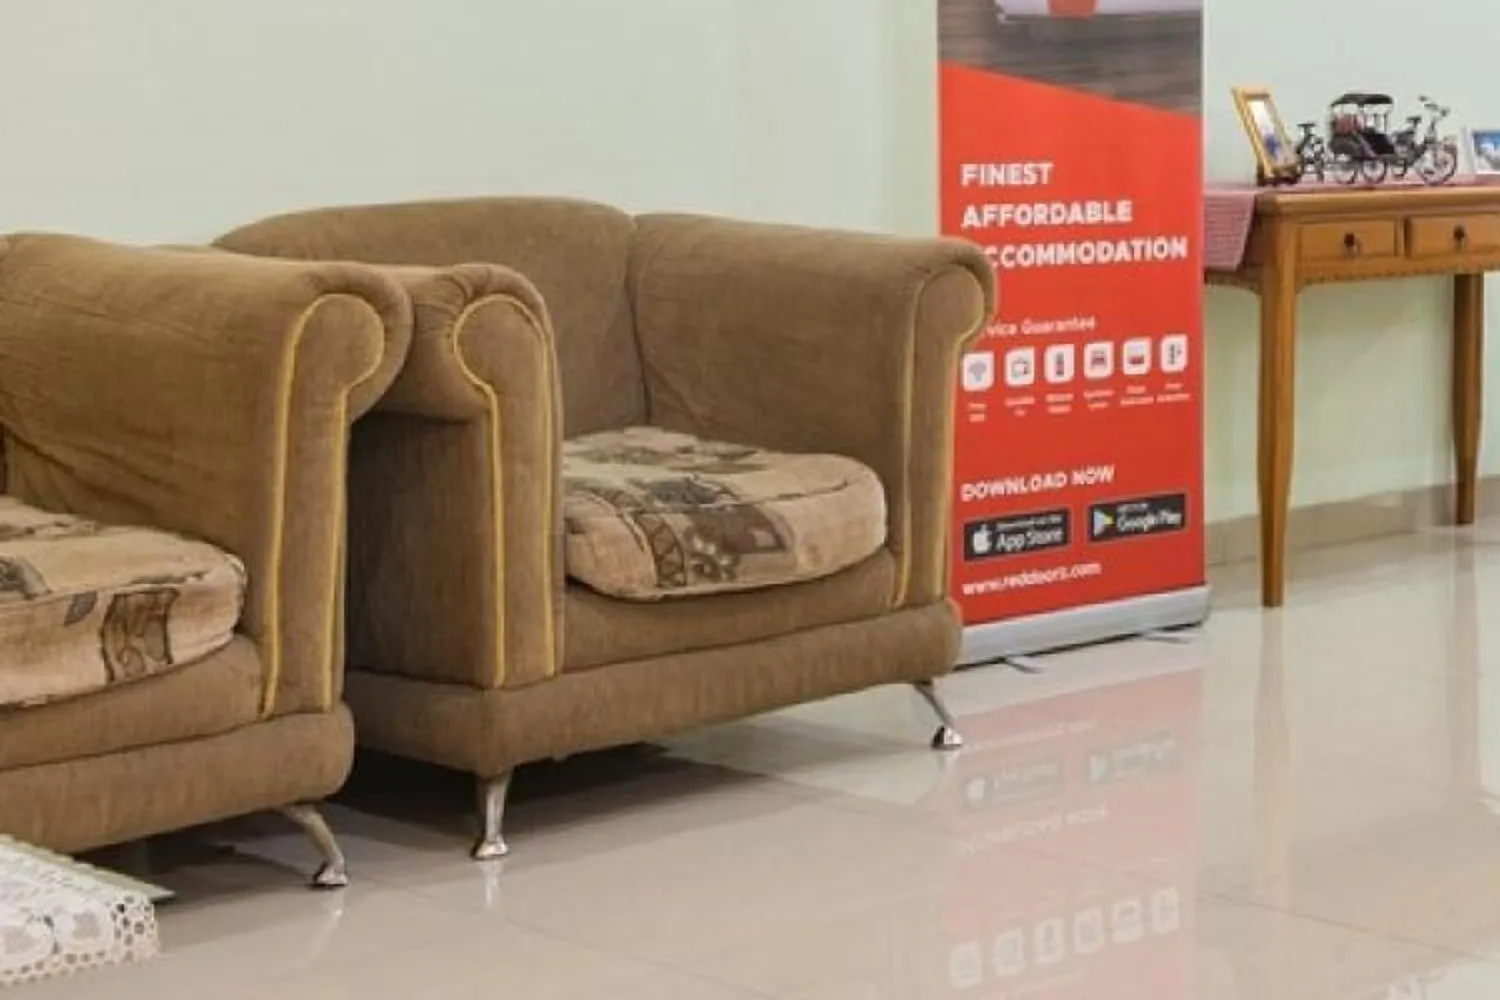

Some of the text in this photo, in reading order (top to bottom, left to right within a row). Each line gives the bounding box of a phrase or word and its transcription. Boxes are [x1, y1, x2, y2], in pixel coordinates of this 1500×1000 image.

[961, 162, 1053, 186] FINEST
[961, 201, 1133, 227] AFFORDABLE
[982, 237, 1188, 269] CCOMMODATION
[961, 465, 1115, 501] DOWNLOAD NOW
[1117, 512, 1157, 533] Google
[995, 527, 1063, 553] App Store
